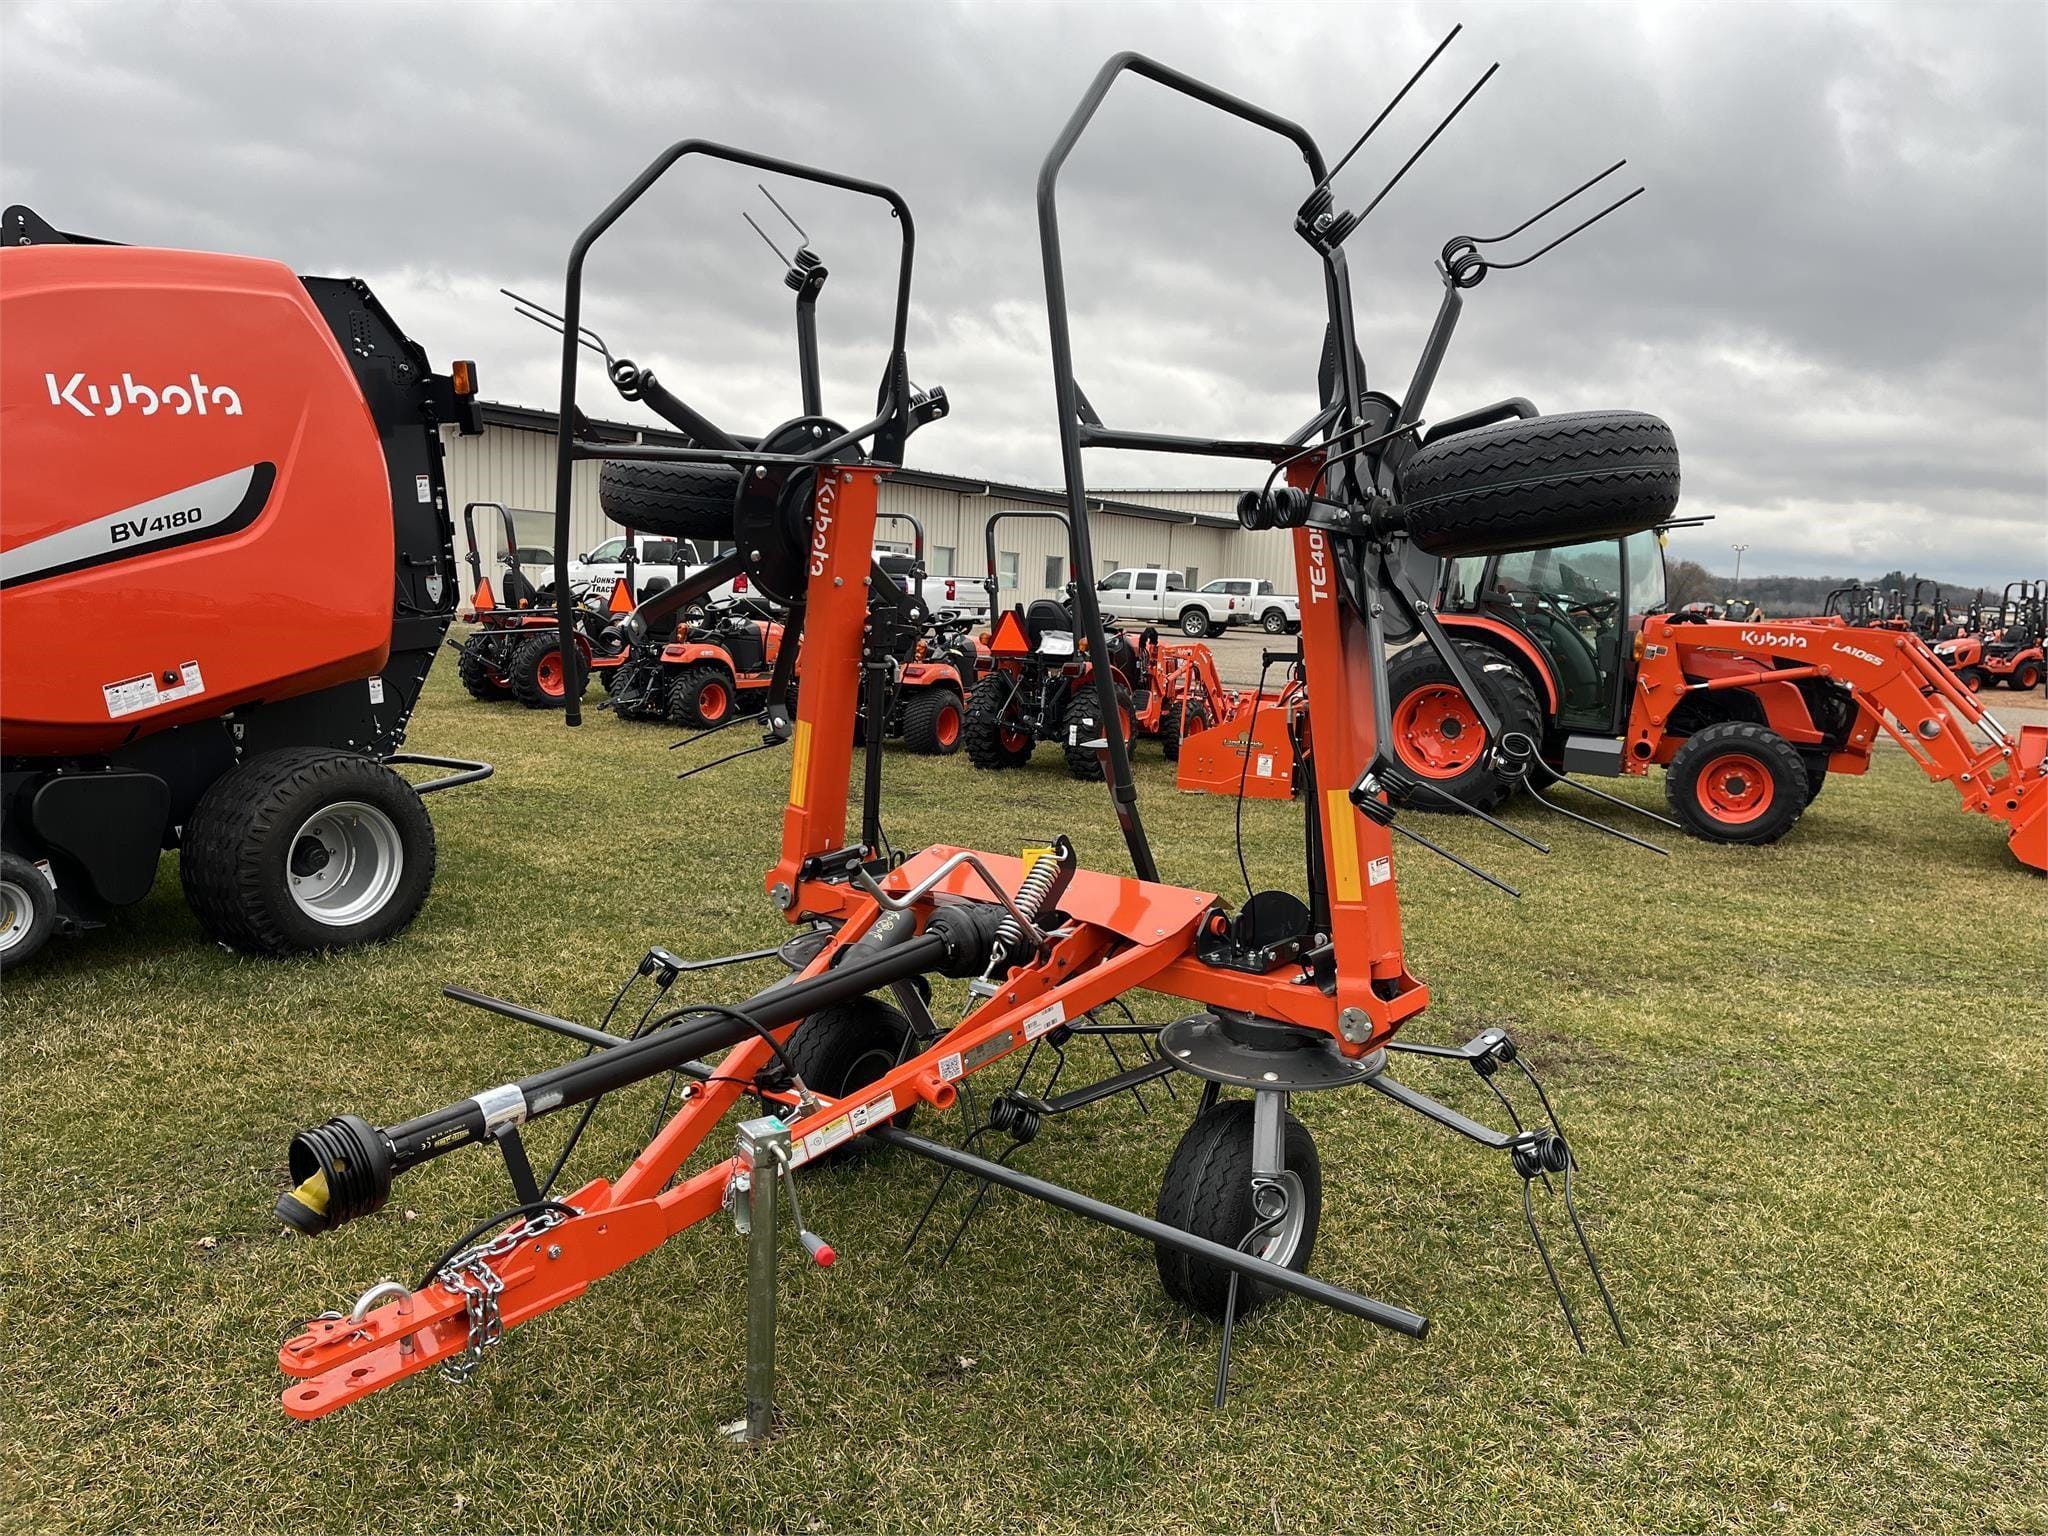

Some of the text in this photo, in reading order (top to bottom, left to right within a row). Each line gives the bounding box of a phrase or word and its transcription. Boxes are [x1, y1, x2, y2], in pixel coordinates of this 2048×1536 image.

[45, 373, 243, 416] Kubota
[110, 507, 203, 544] BV4180
[811, 478, 837, 577] Kubota
[1741, 630, 1808, 648] Kubota
[1832, 642, 1885, 667] LA1065
